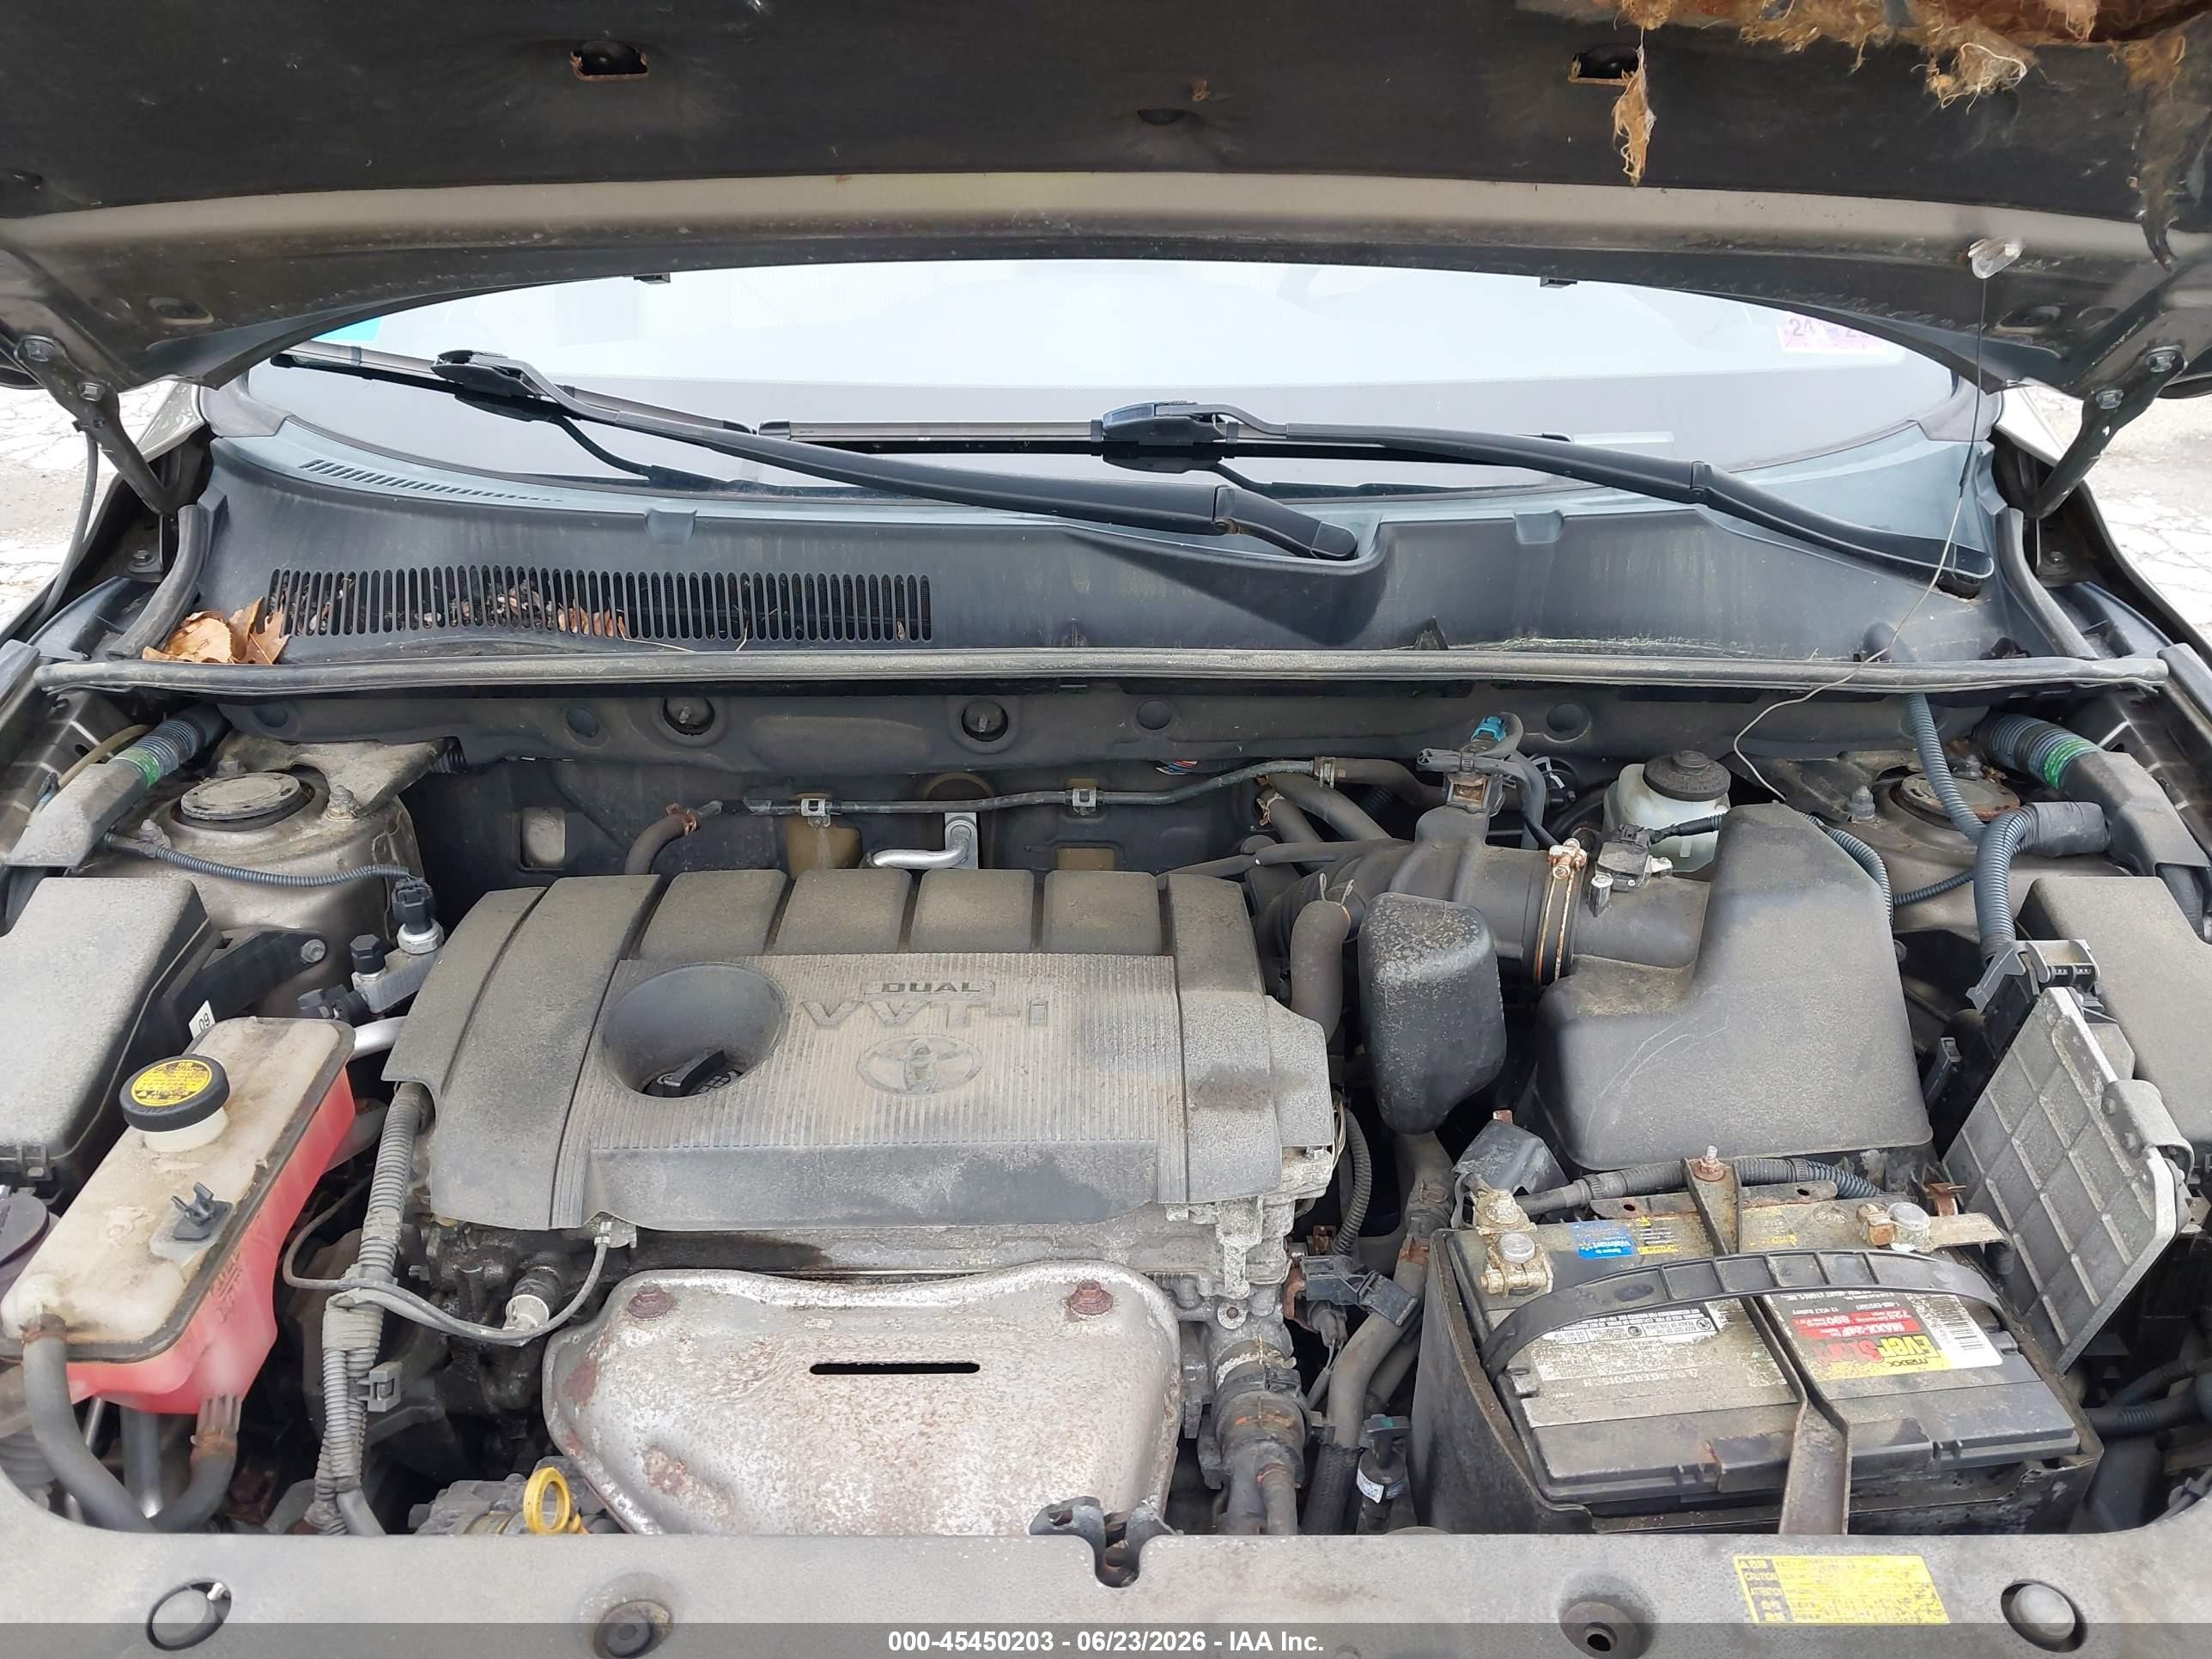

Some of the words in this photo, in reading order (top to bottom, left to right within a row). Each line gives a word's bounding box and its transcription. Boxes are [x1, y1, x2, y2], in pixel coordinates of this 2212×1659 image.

[881, 981, 983, 993] DUAL
[198, 1012, 210, 1031] 09
[1744, 1571, 1778, 1581] CAUTION
